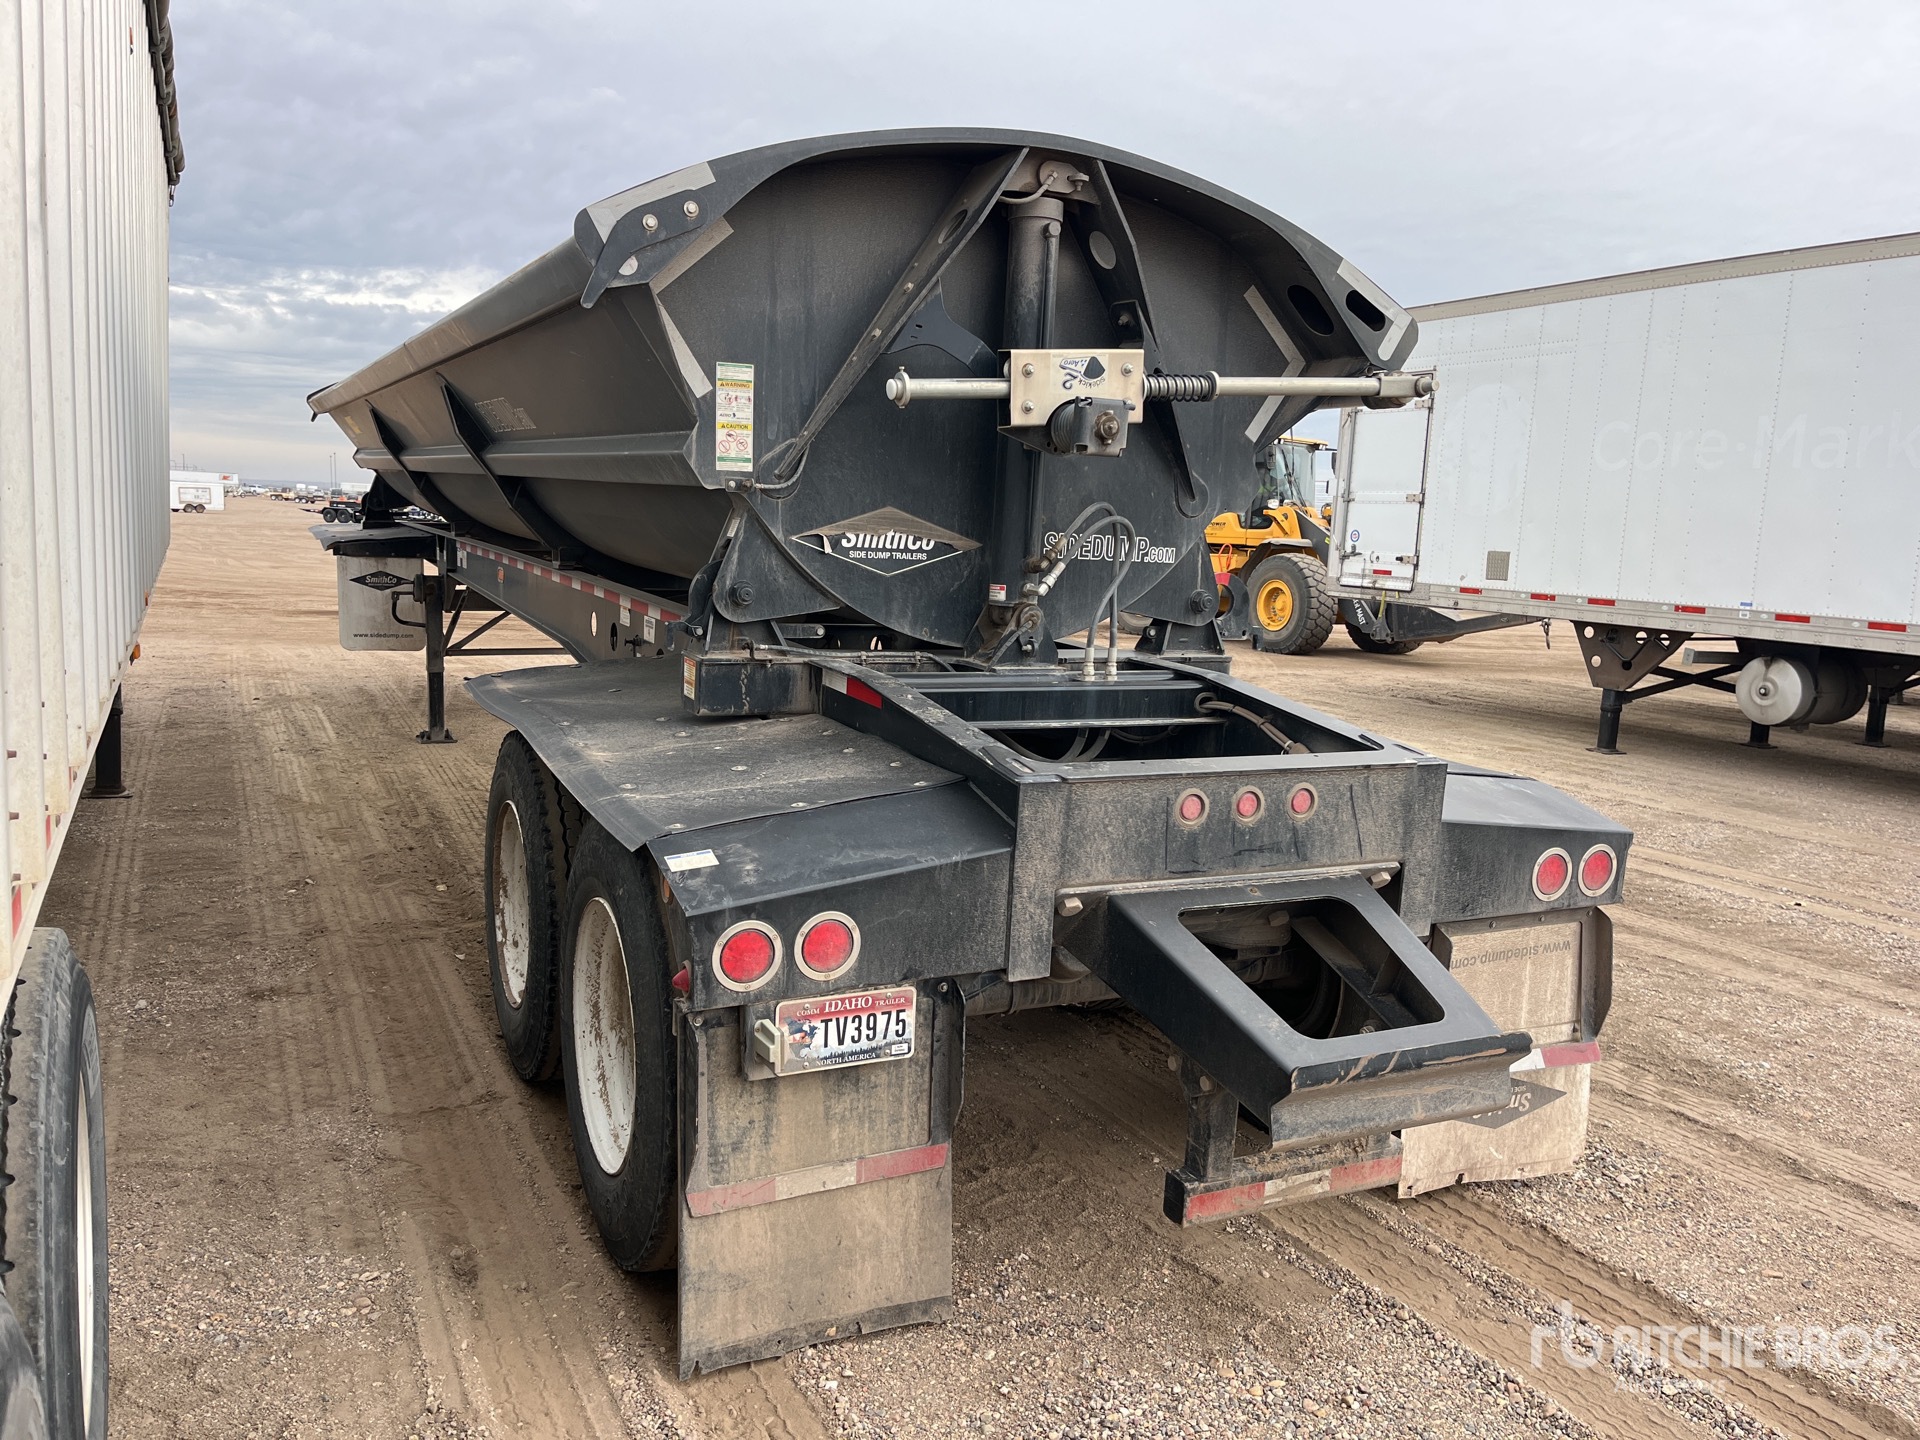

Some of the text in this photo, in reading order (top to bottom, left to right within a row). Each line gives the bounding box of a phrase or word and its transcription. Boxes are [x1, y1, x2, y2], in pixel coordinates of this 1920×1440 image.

[1062, 372, 1078, 390] 2
[849, 550, 928, 561] SIDE DUMP TRAILERS
[365, 575, 397, 584] SmithCo
[353, 632, 414, 640] www.sidedump.com
[1451, 940, 1571, 970] www.sidedump.com
[796, 995, 906, 1017] COMM IDAHO TRAILER
[820, 1008, 907, 1049] TV3975
[815, 1052, 877, 1067] NORTH AMERICA
